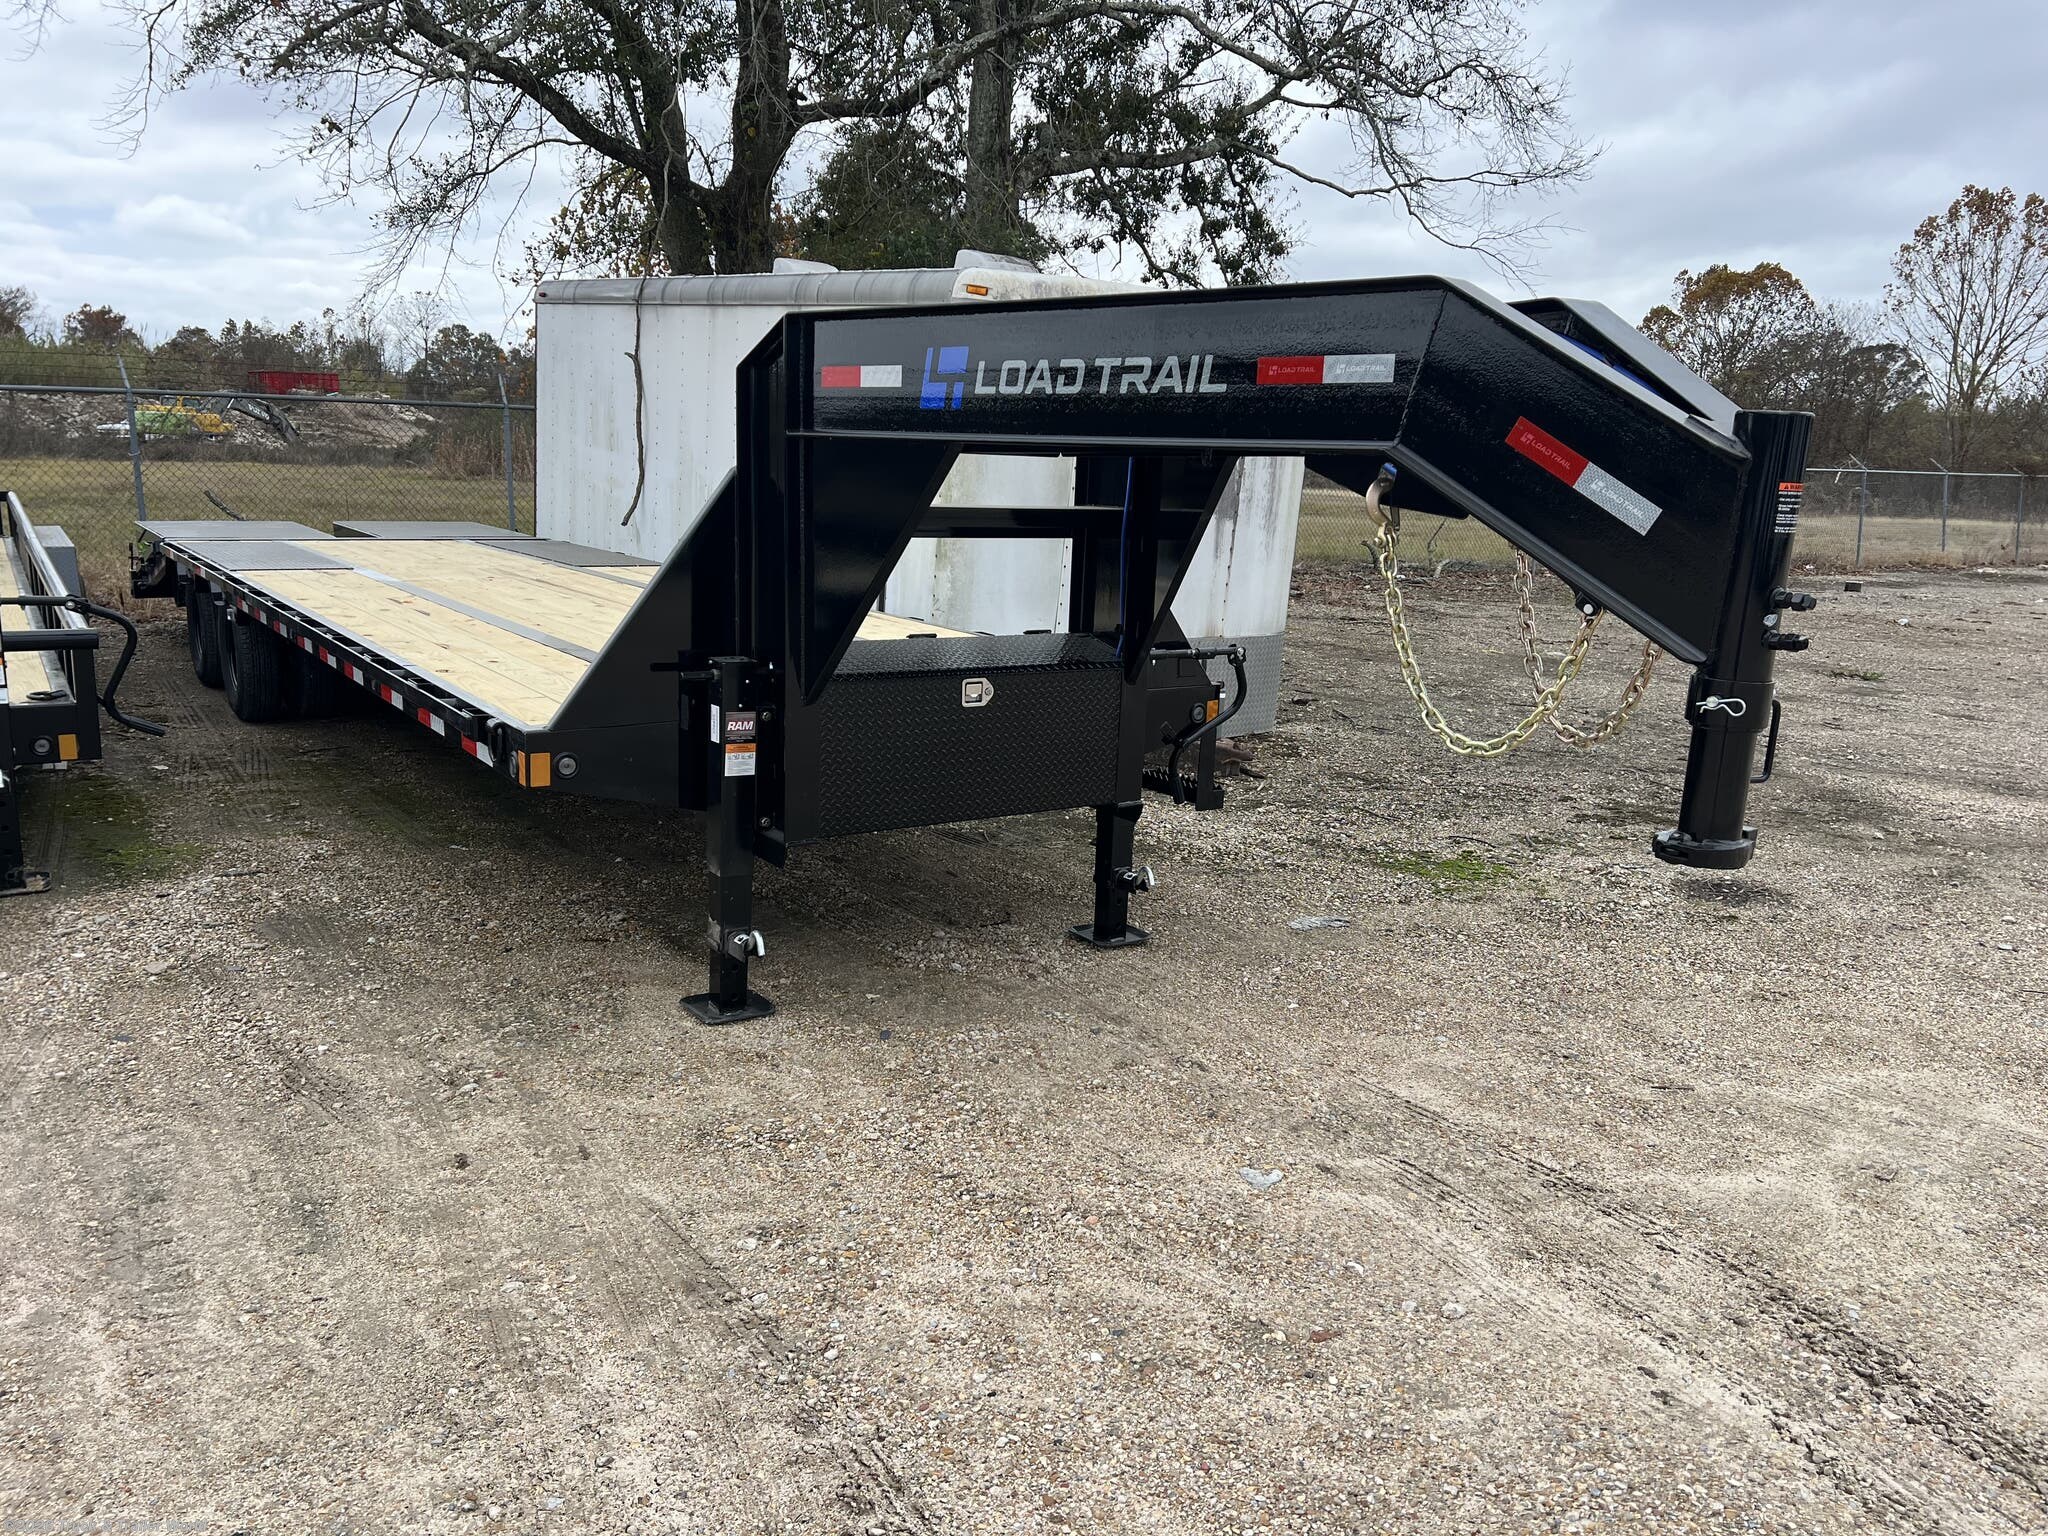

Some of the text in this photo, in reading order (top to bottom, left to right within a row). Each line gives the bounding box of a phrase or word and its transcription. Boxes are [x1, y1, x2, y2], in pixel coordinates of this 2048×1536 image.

[974, 354, 1228, 395] LOAD TRAIL
[1278, 365, 1316, 374] LOAD TRAIL
[1345, 363, 1387, 373] LOAD TRAIL
[1531, 440, 1571, 470] LOAD TRAIL
[1602, 488, 1644, 519] LOAD TRAIL
[727, 720, 754, 731] RAM
